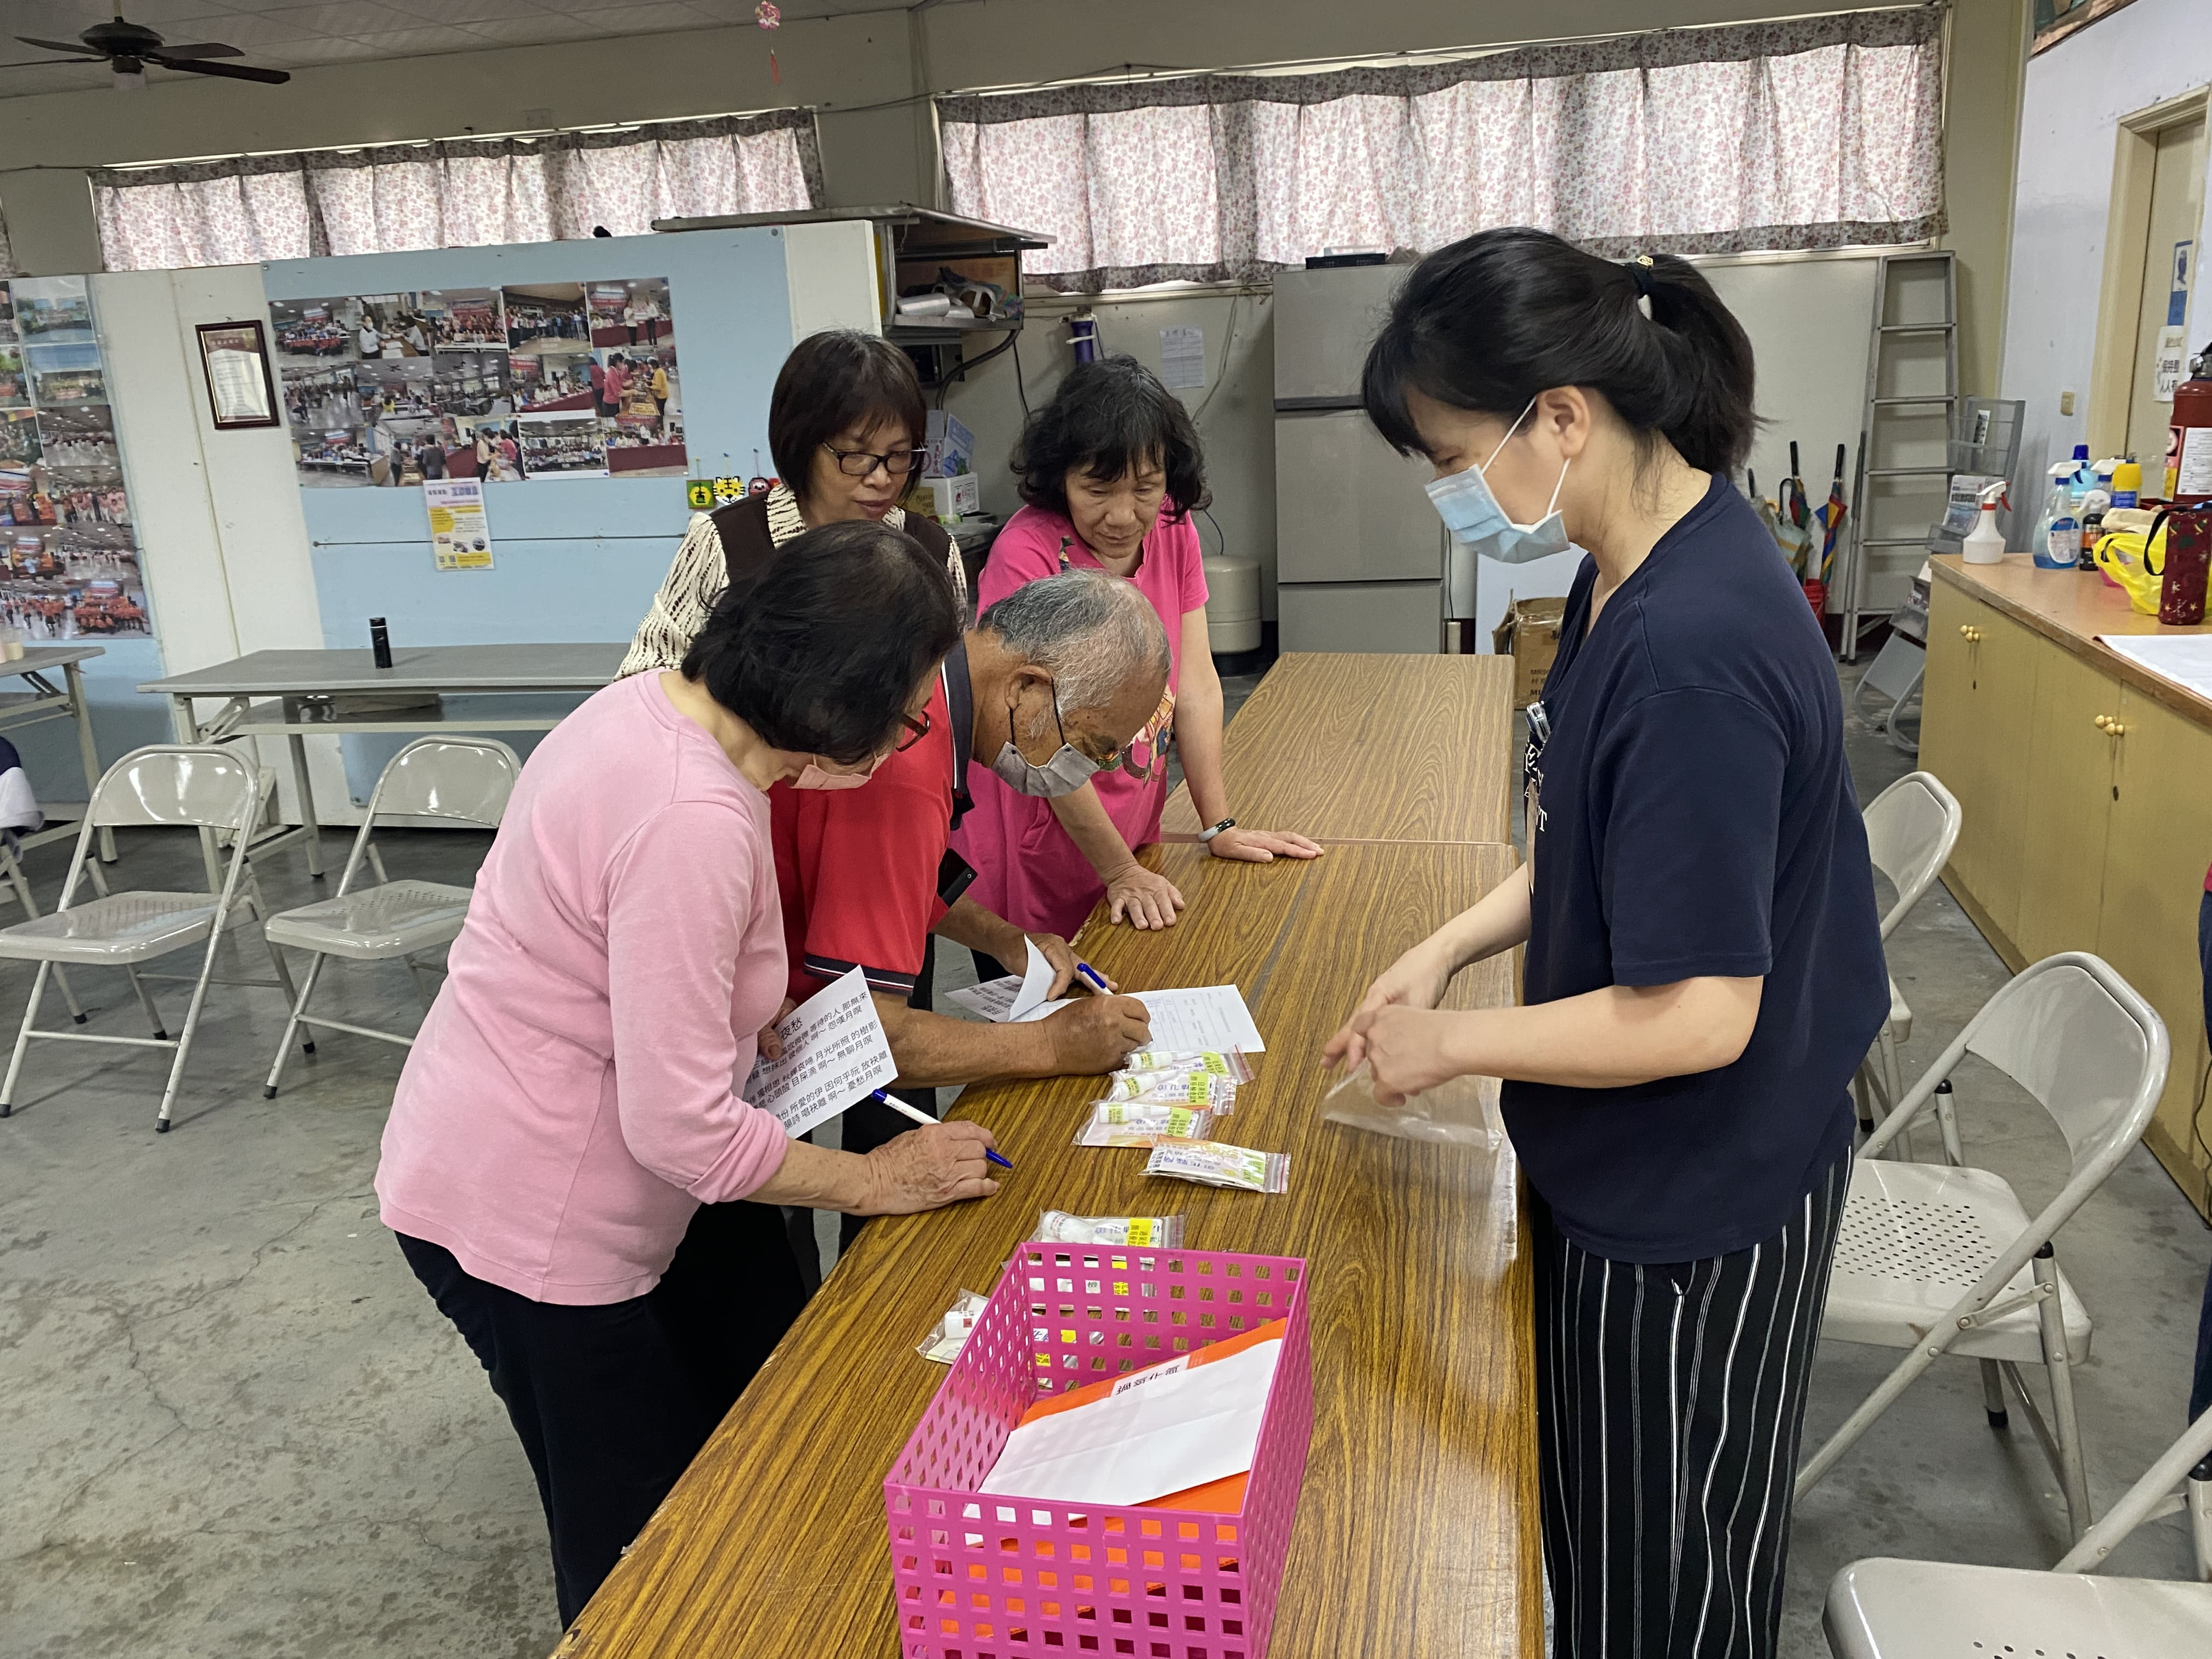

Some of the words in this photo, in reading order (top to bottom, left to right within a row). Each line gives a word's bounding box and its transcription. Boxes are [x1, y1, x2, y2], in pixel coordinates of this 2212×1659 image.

[810, 1008, 840, 1031] 等待的人
[816, 1035, 850, 1061] 月光所照
[851, 1019, 878, 1040] 的樹影
[768, 1082, 791, 1103] 心頭酸
[792, 1066, 816, 1087] 目屎滴
[790, 1087, 823, 1113] 所愛的伊
[824, 1066, 860, 1092] 因何乎阮
